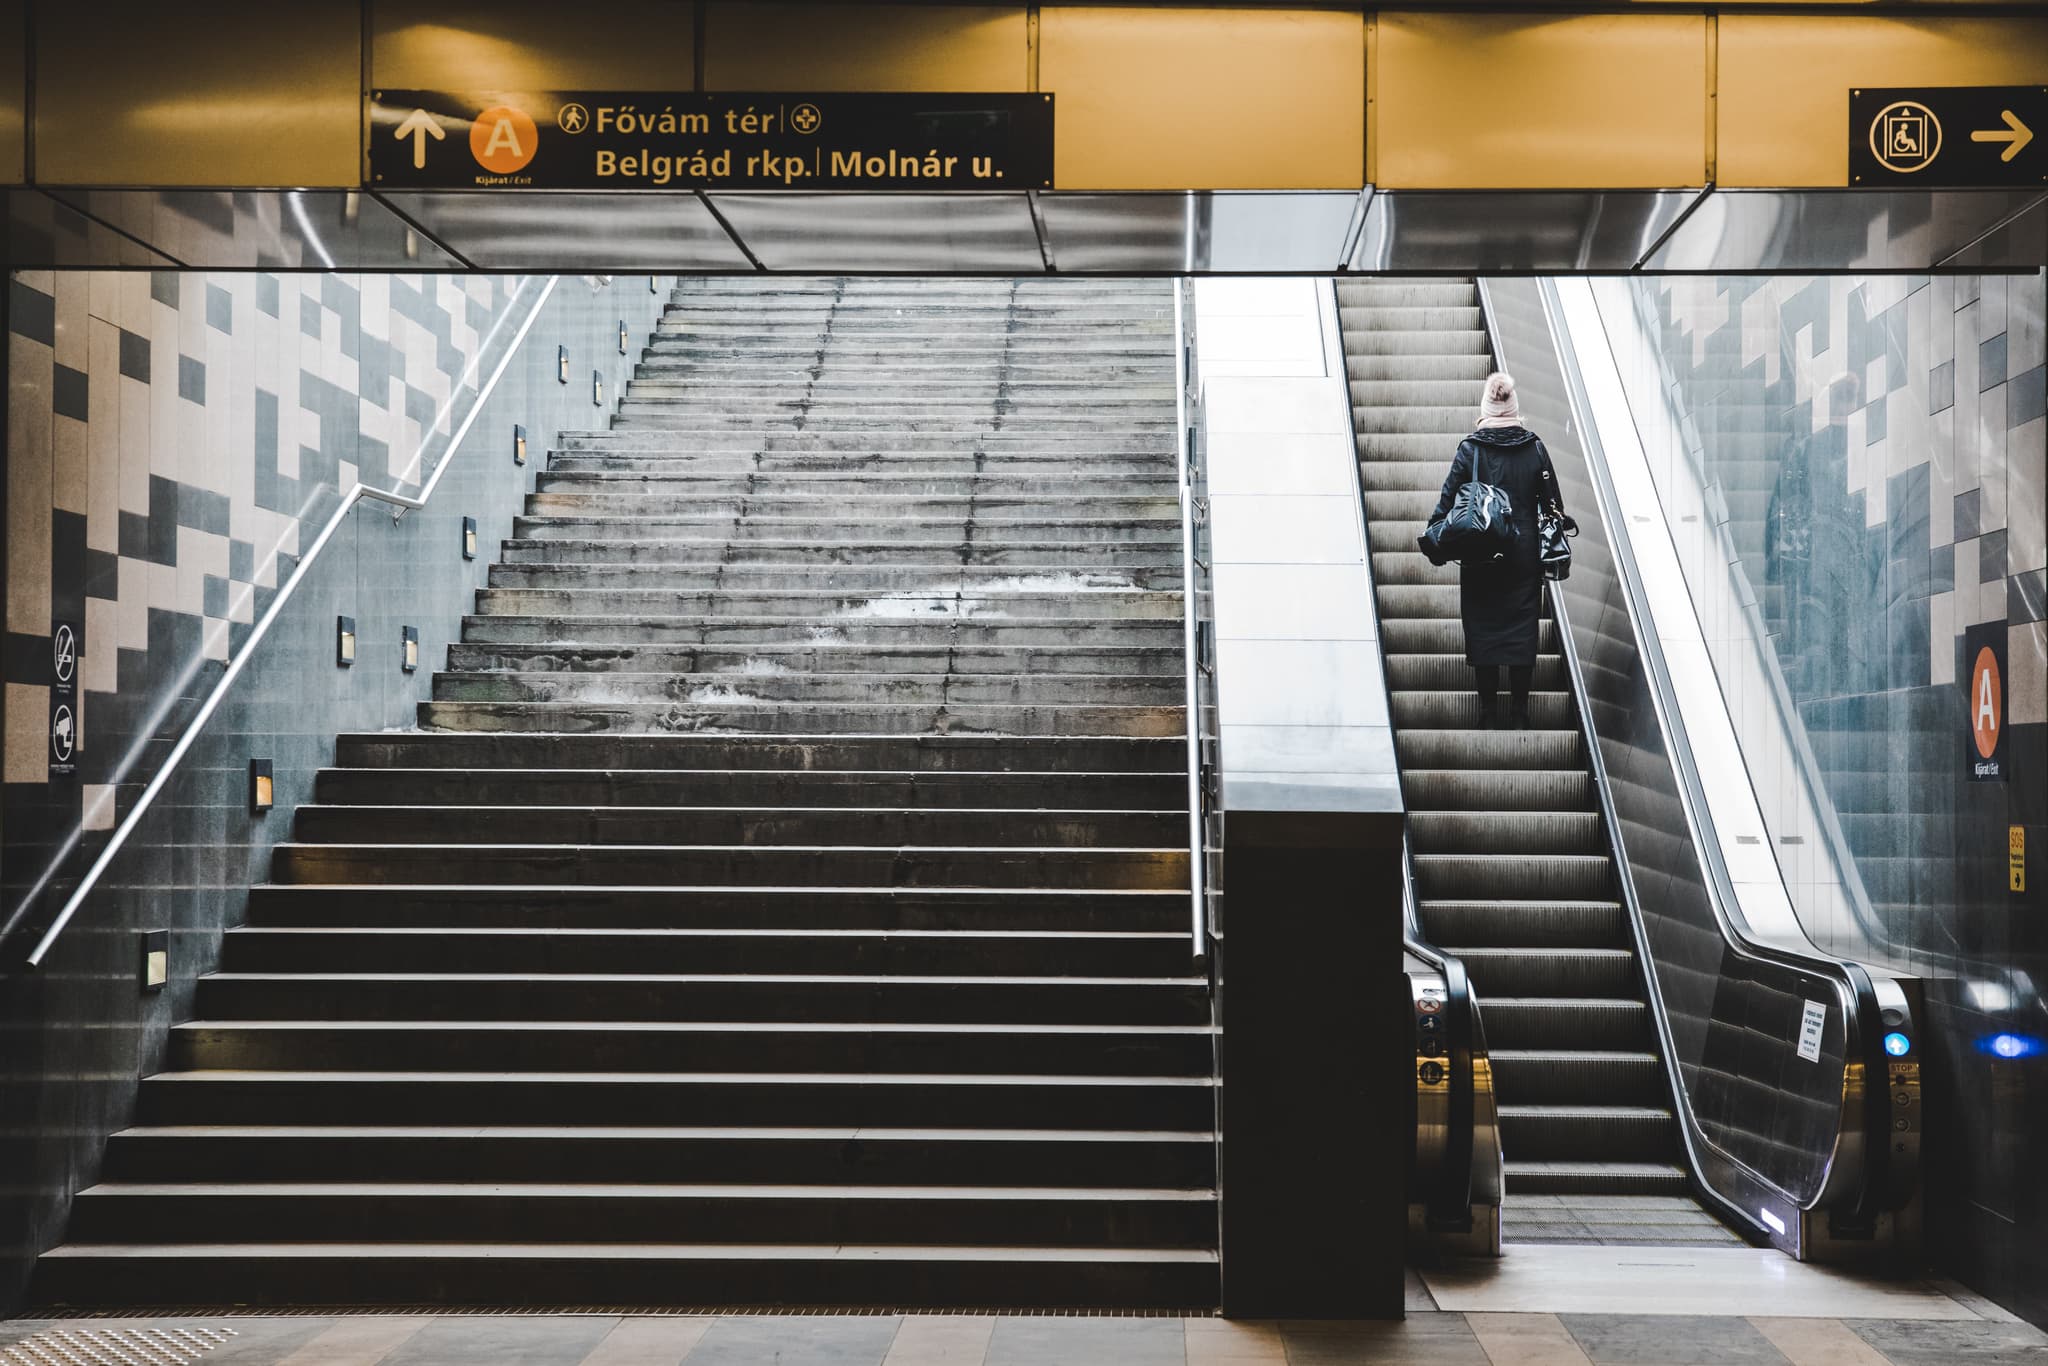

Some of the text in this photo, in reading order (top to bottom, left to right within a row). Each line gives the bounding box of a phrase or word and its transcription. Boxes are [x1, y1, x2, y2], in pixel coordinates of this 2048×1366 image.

[596, 106, 775, 134] Fővám tér
[483, 118, 524, 157] A
[596, 149, 812, 184] Belgrád rkp.
[831, 149, 1004, 178] Molnár u.
[1977, 668, 1996, 731] A
[2010, 831, 2024, 849] SOS
[1890, 1063, 1914, 1073] STOP
